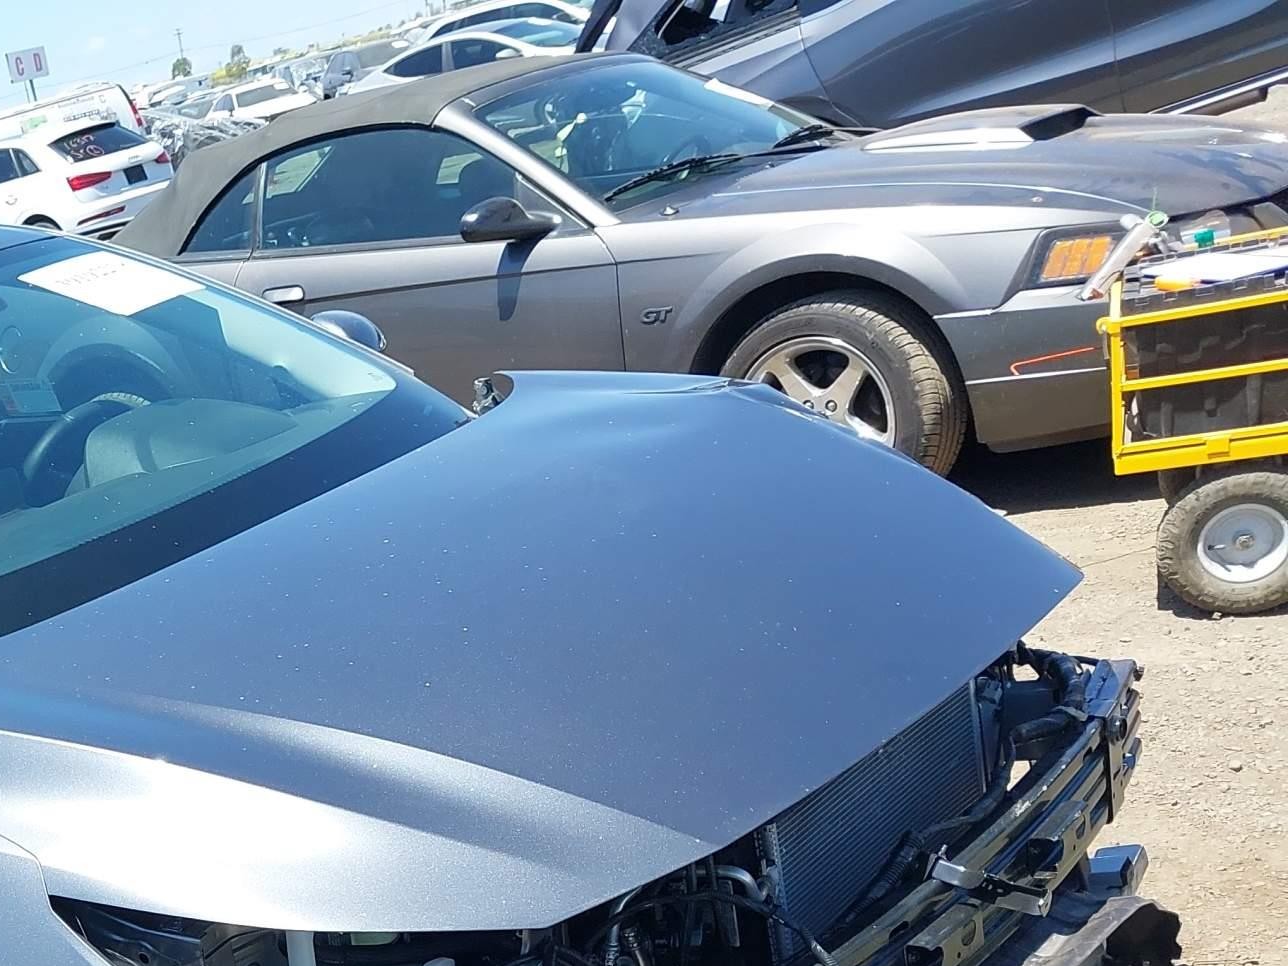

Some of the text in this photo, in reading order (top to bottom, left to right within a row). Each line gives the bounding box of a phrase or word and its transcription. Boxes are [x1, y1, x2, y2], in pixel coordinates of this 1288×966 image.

[15, 52, 43, 76] C D
[640, 305, 673, 325] GT
